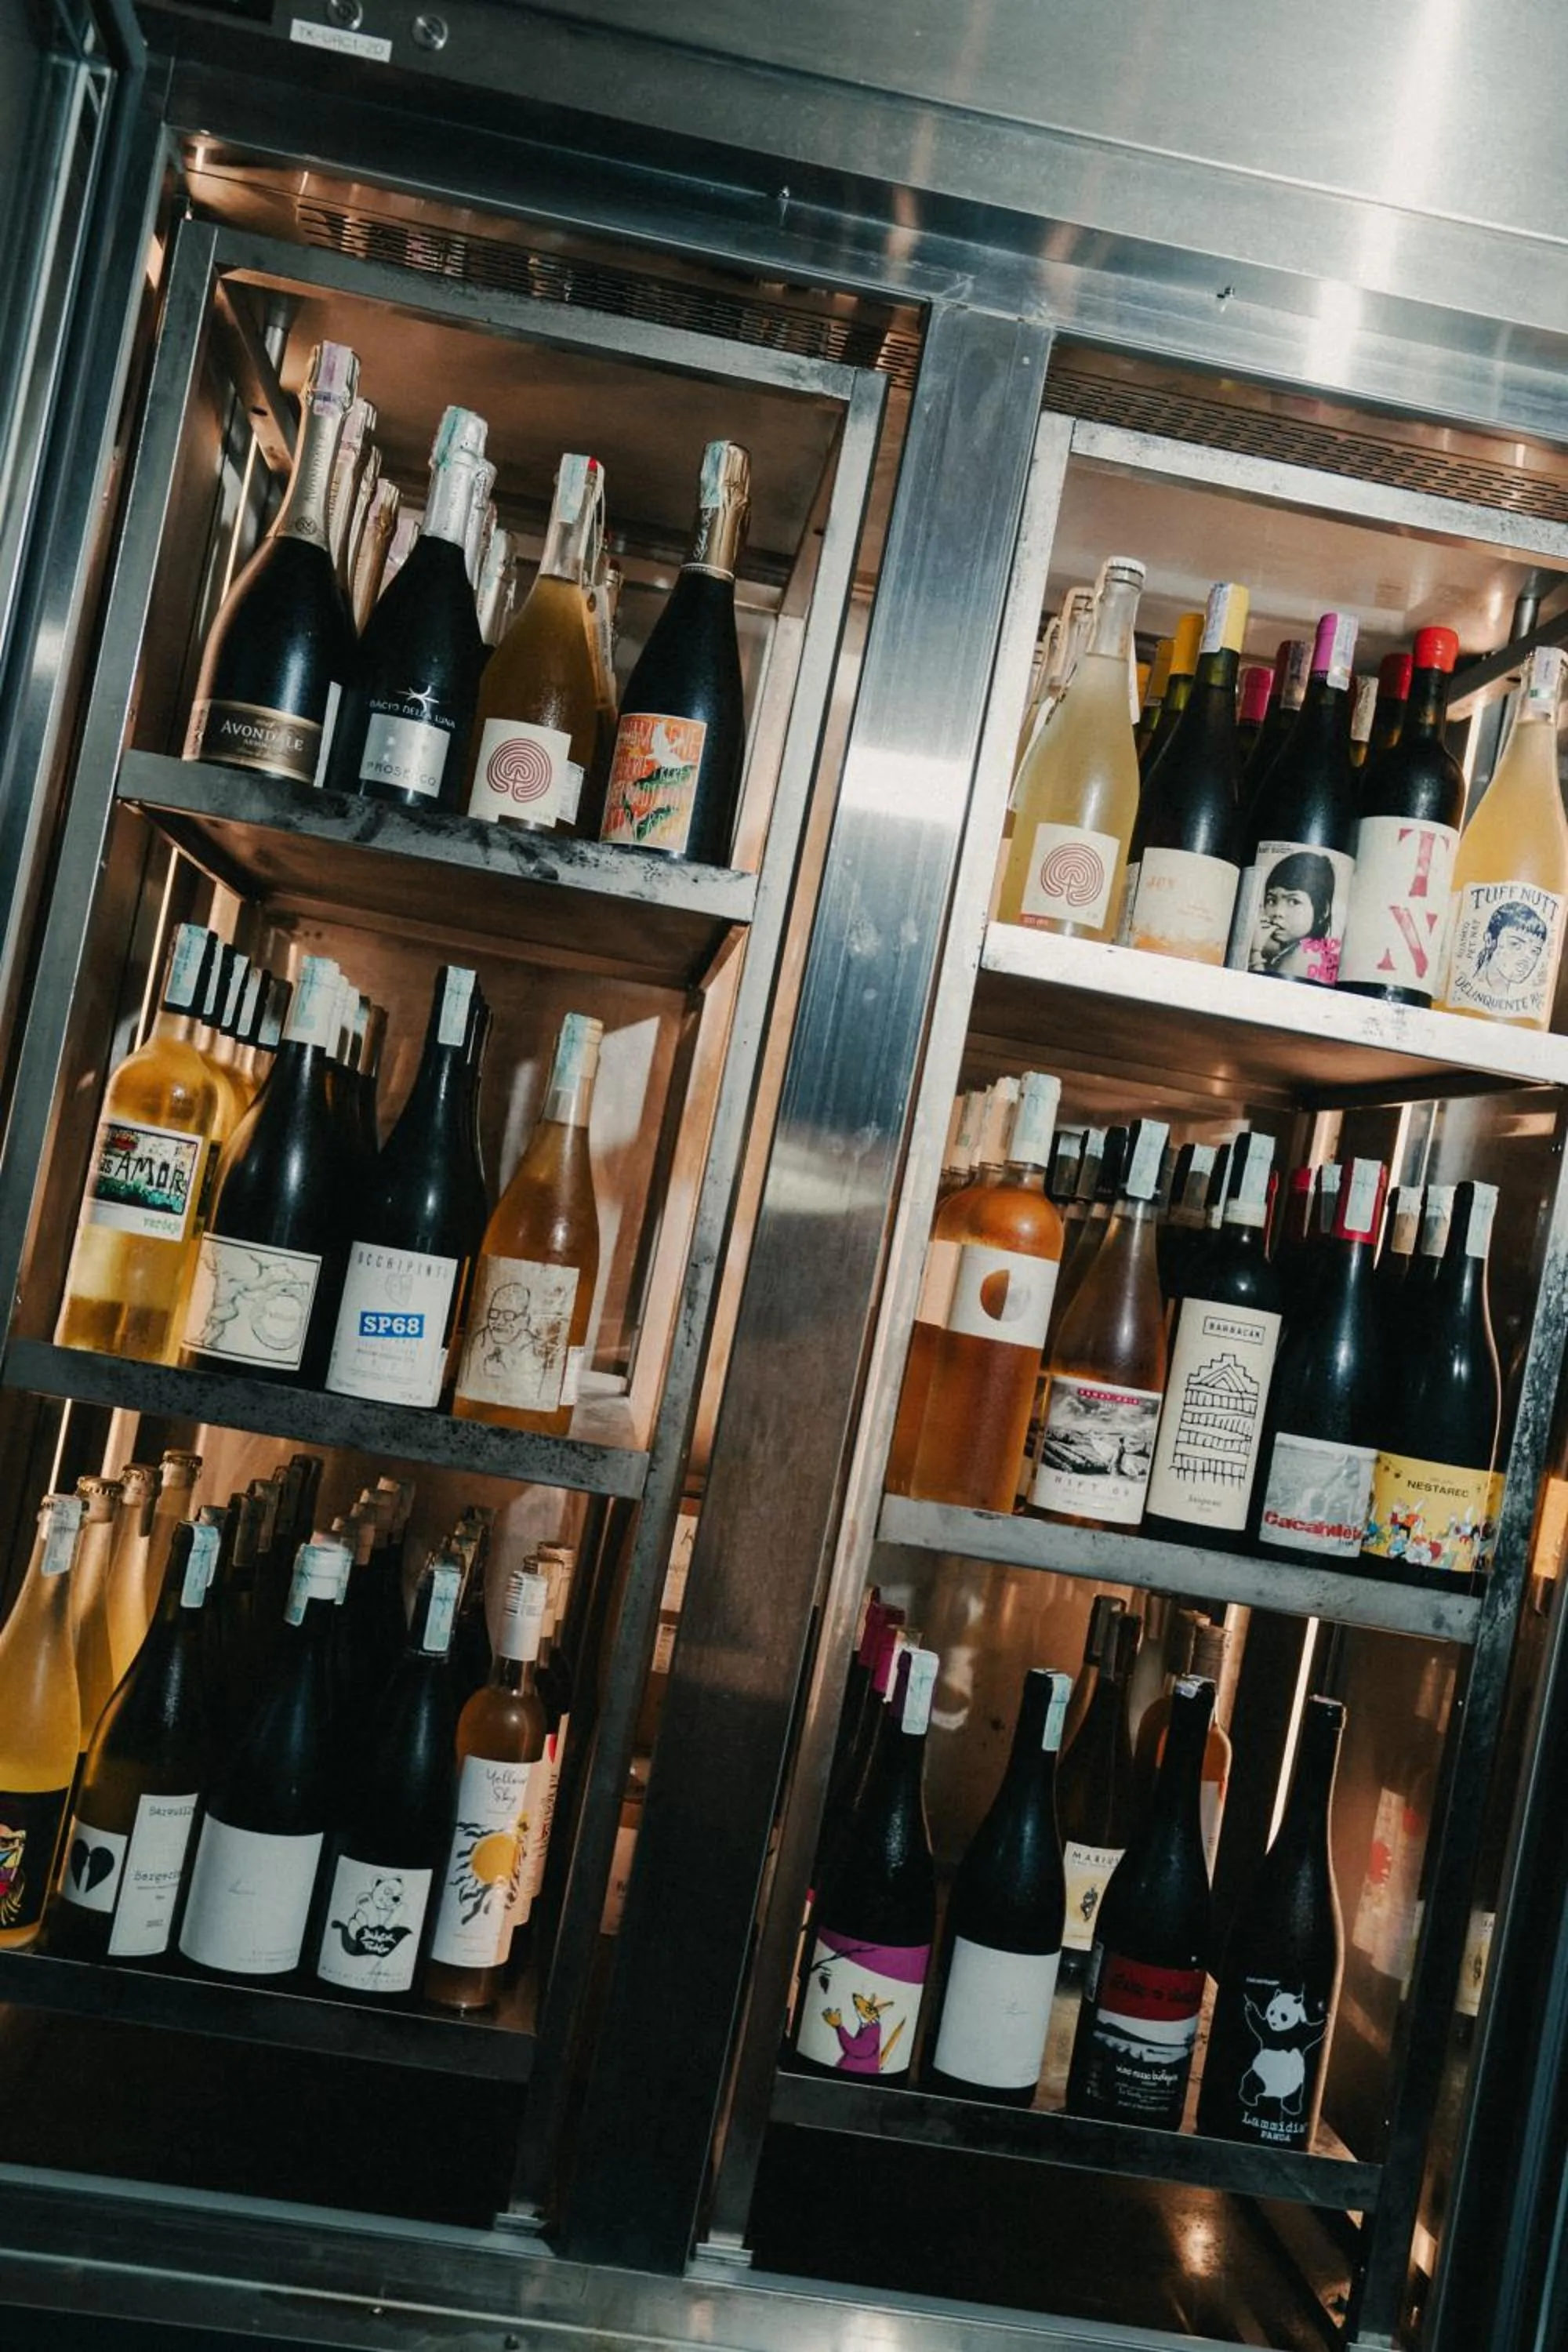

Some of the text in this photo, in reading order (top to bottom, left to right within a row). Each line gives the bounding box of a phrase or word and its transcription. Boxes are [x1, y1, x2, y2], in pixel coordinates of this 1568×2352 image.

[367, 760, 437, 786] PROSECO
[1471, 885, 1559, 921] TUFF NUTT
[363, 1314, 420, 1336] SP68
[1406, 1479, 1470, 1498] NESTAREC
[492, 1786, 517, 1810] Sky
